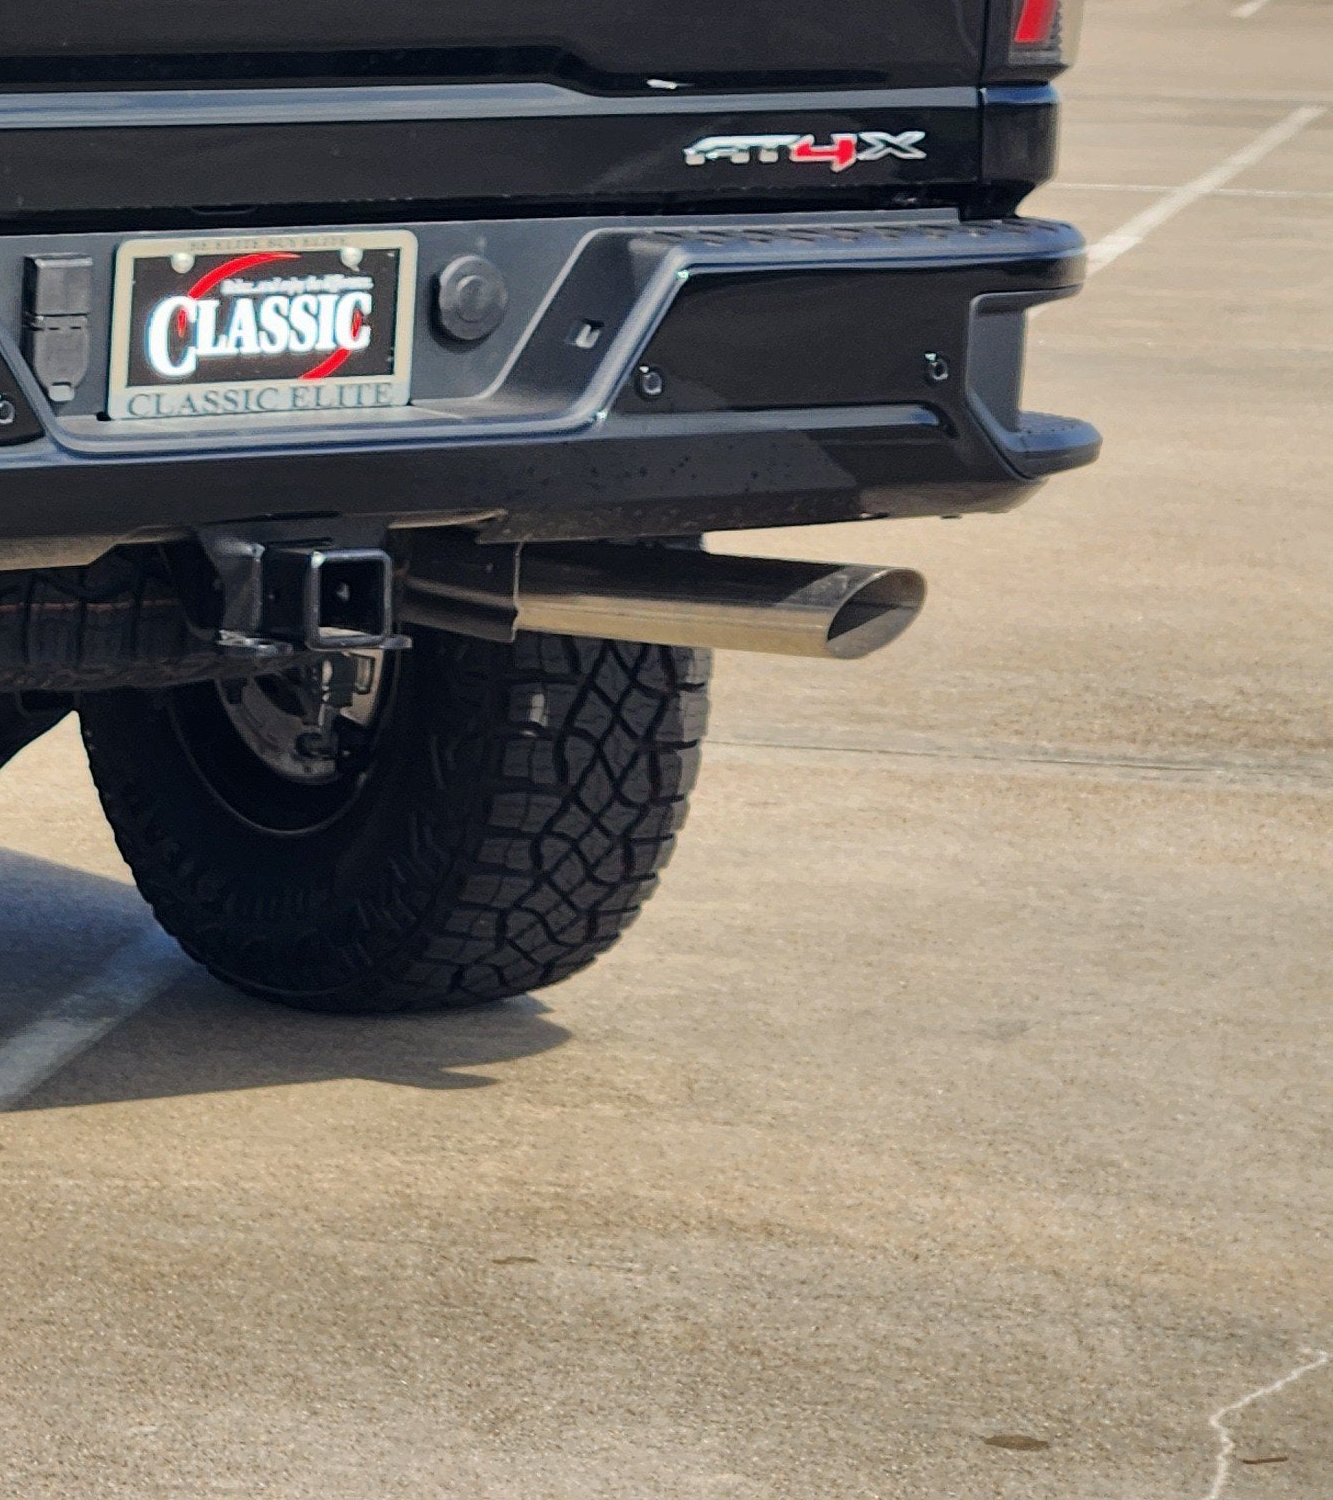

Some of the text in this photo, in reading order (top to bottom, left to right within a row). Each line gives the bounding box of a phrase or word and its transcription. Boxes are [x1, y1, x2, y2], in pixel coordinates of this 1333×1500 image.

[683, 131, 926, 172] AT4X
[147, 293, 372, 377] CLASSIC
[128, 383, 392, 416] CLASSIC ELITE
